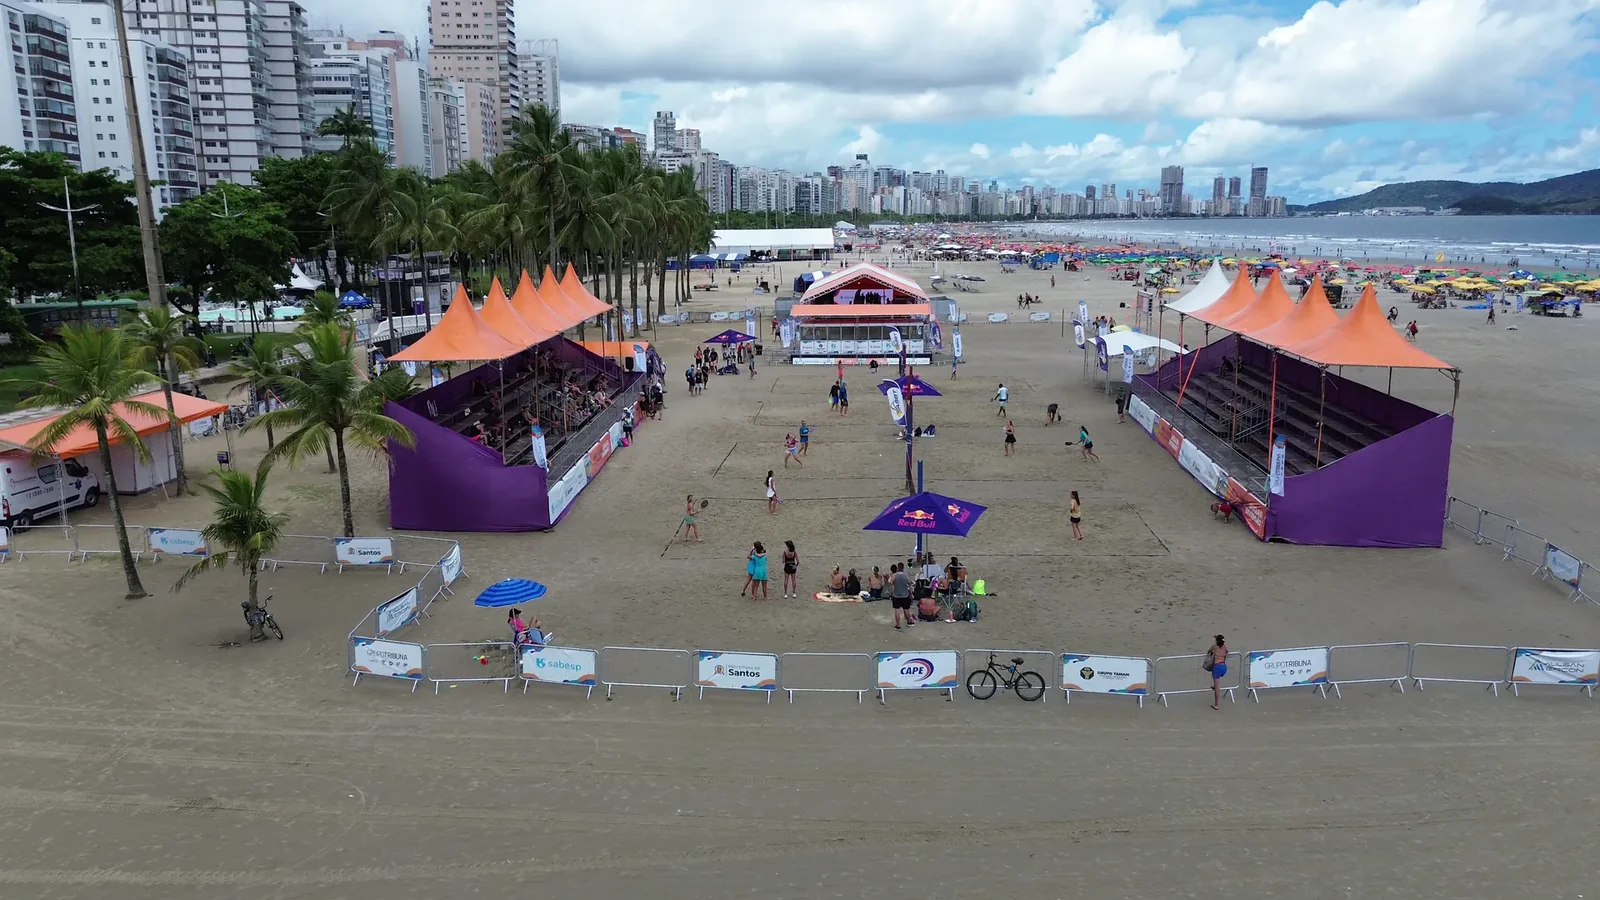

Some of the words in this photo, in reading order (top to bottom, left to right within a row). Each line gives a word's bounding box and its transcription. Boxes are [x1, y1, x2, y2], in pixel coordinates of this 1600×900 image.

[897, 518, 916, 527] Red
[917, 519, 936, 529] Bull
[548, 660, 582, 672] sabesp
[1264, 660, 1312, 670] GRUPOTRIBUNA
[728, 668, 760, 678] Santos
[900, 666, 924, 675] CAPE
